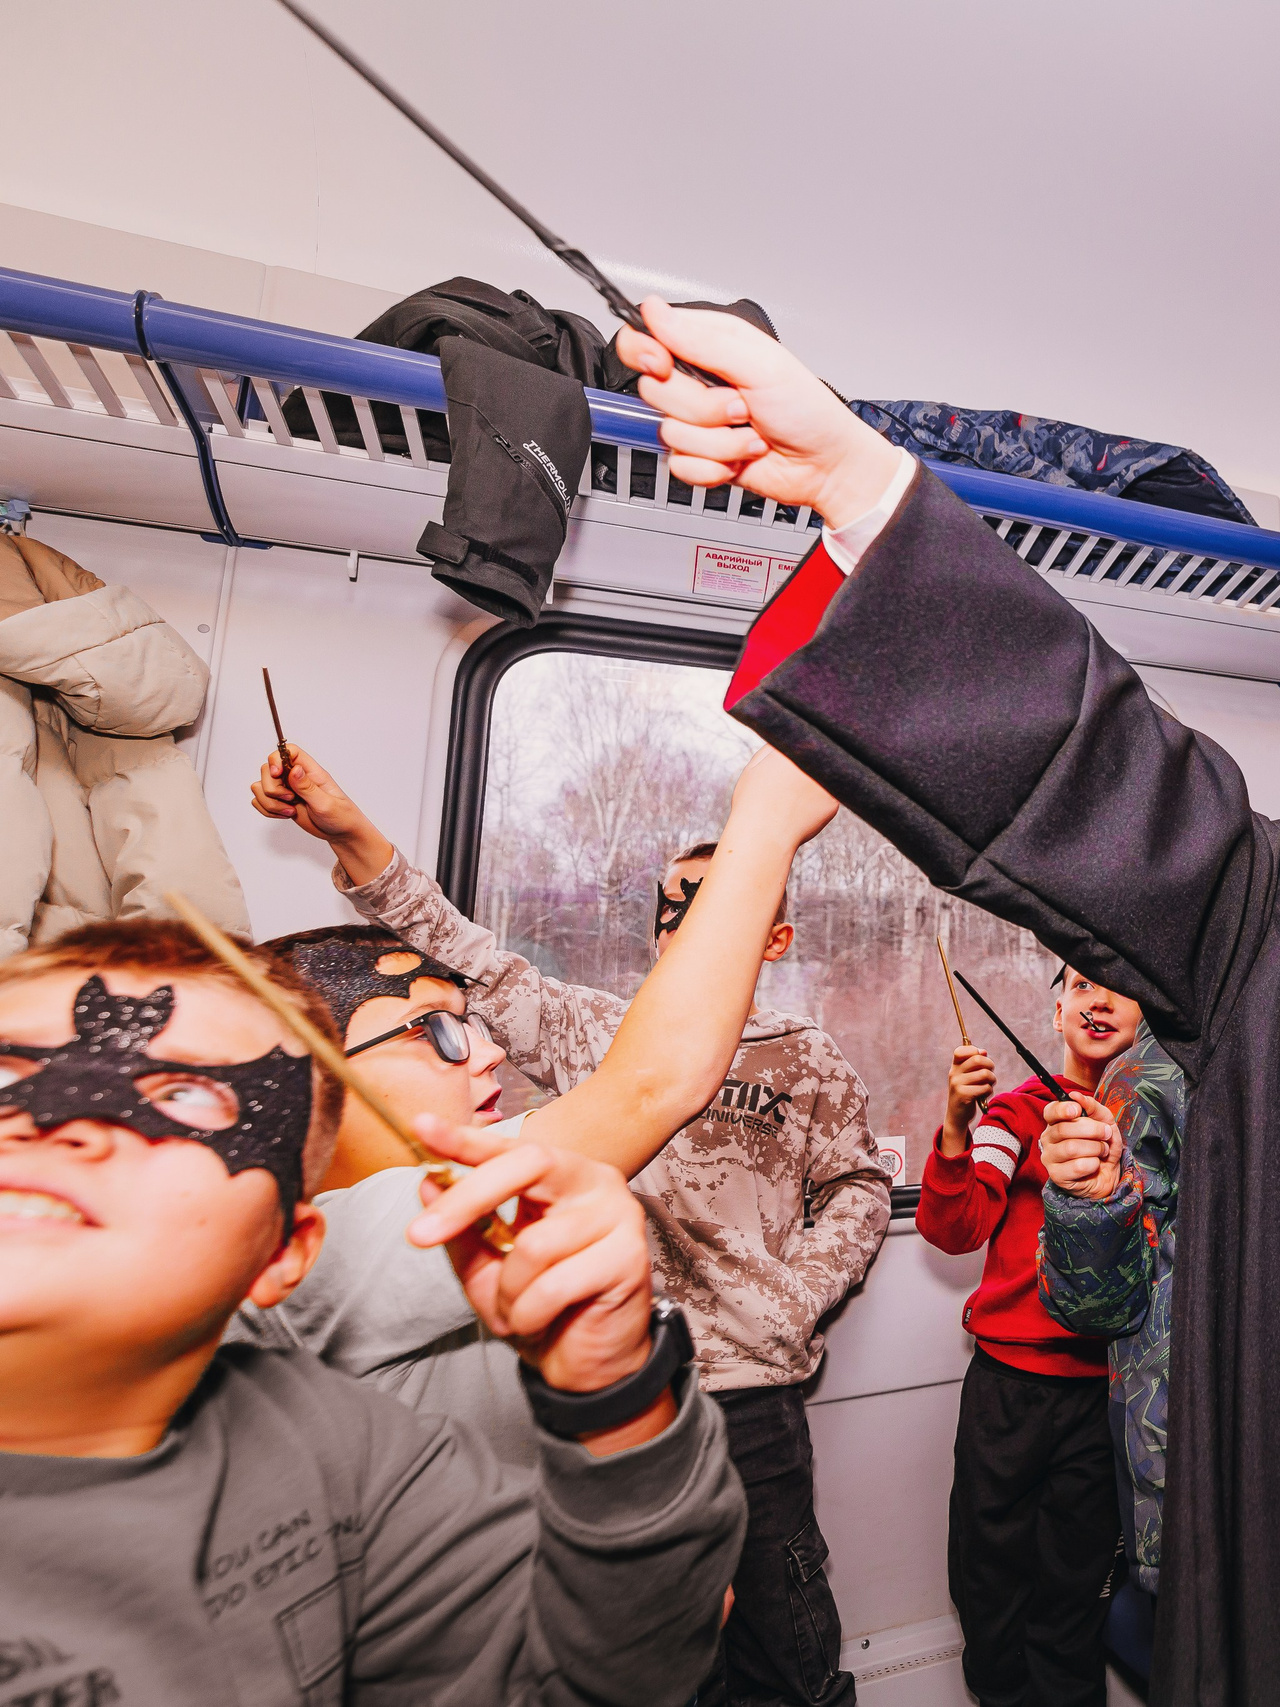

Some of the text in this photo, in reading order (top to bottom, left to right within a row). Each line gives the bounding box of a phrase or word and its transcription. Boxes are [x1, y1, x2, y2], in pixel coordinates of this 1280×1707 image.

[705, 552, 763, 567] АВАРИЙНЫЙ
[716, 561, 750, 573] ВЫХОД
[778, 563, 797, 572] EME
